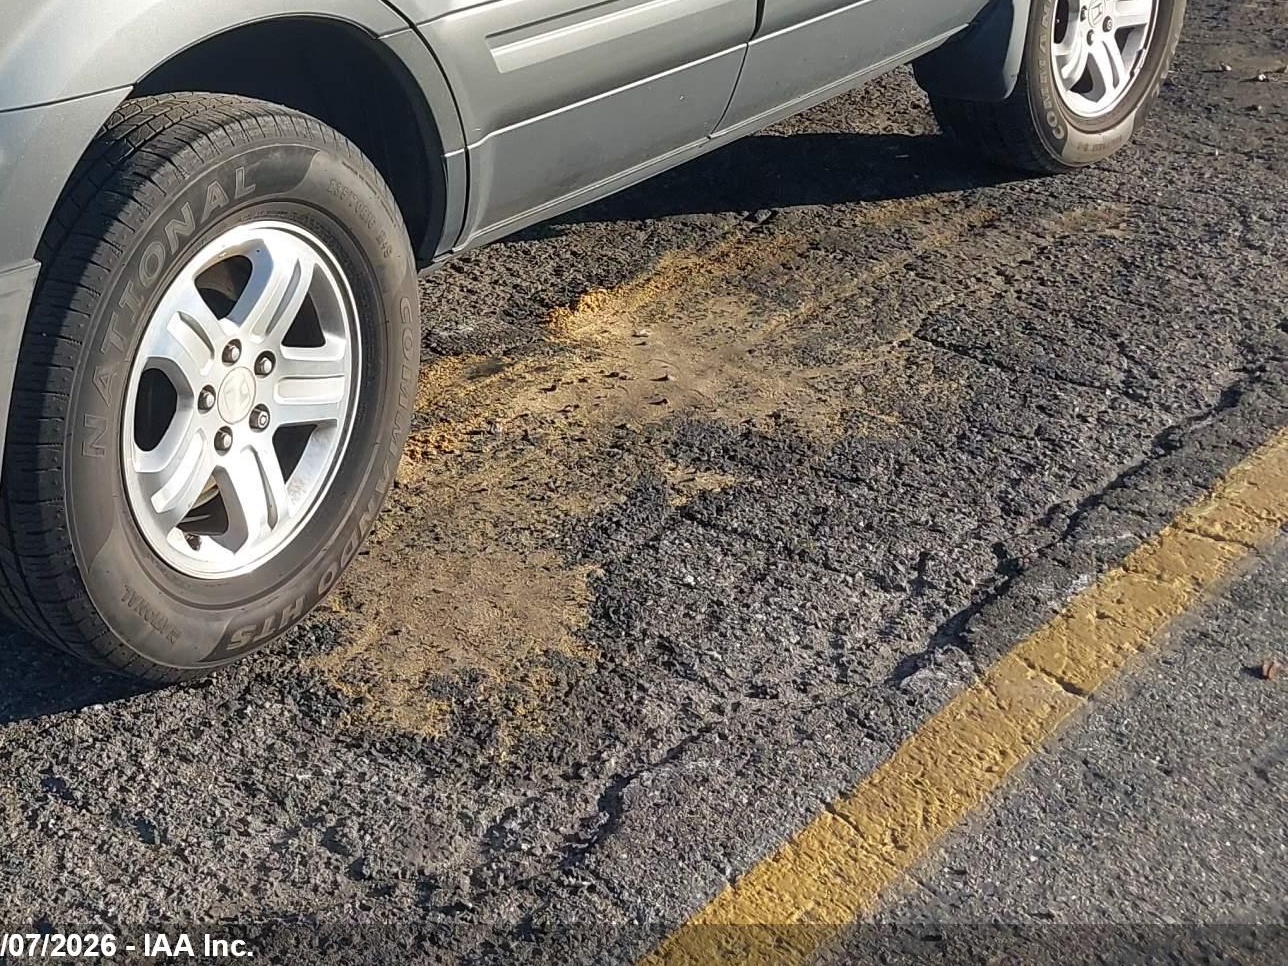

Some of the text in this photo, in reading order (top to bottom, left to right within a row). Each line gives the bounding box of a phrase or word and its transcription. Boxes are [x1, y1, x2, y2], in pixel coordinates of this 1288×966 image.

[81, 165, 256, 459] NATIONAL
[226, 295, 414, 650] COMMANDO HTS
